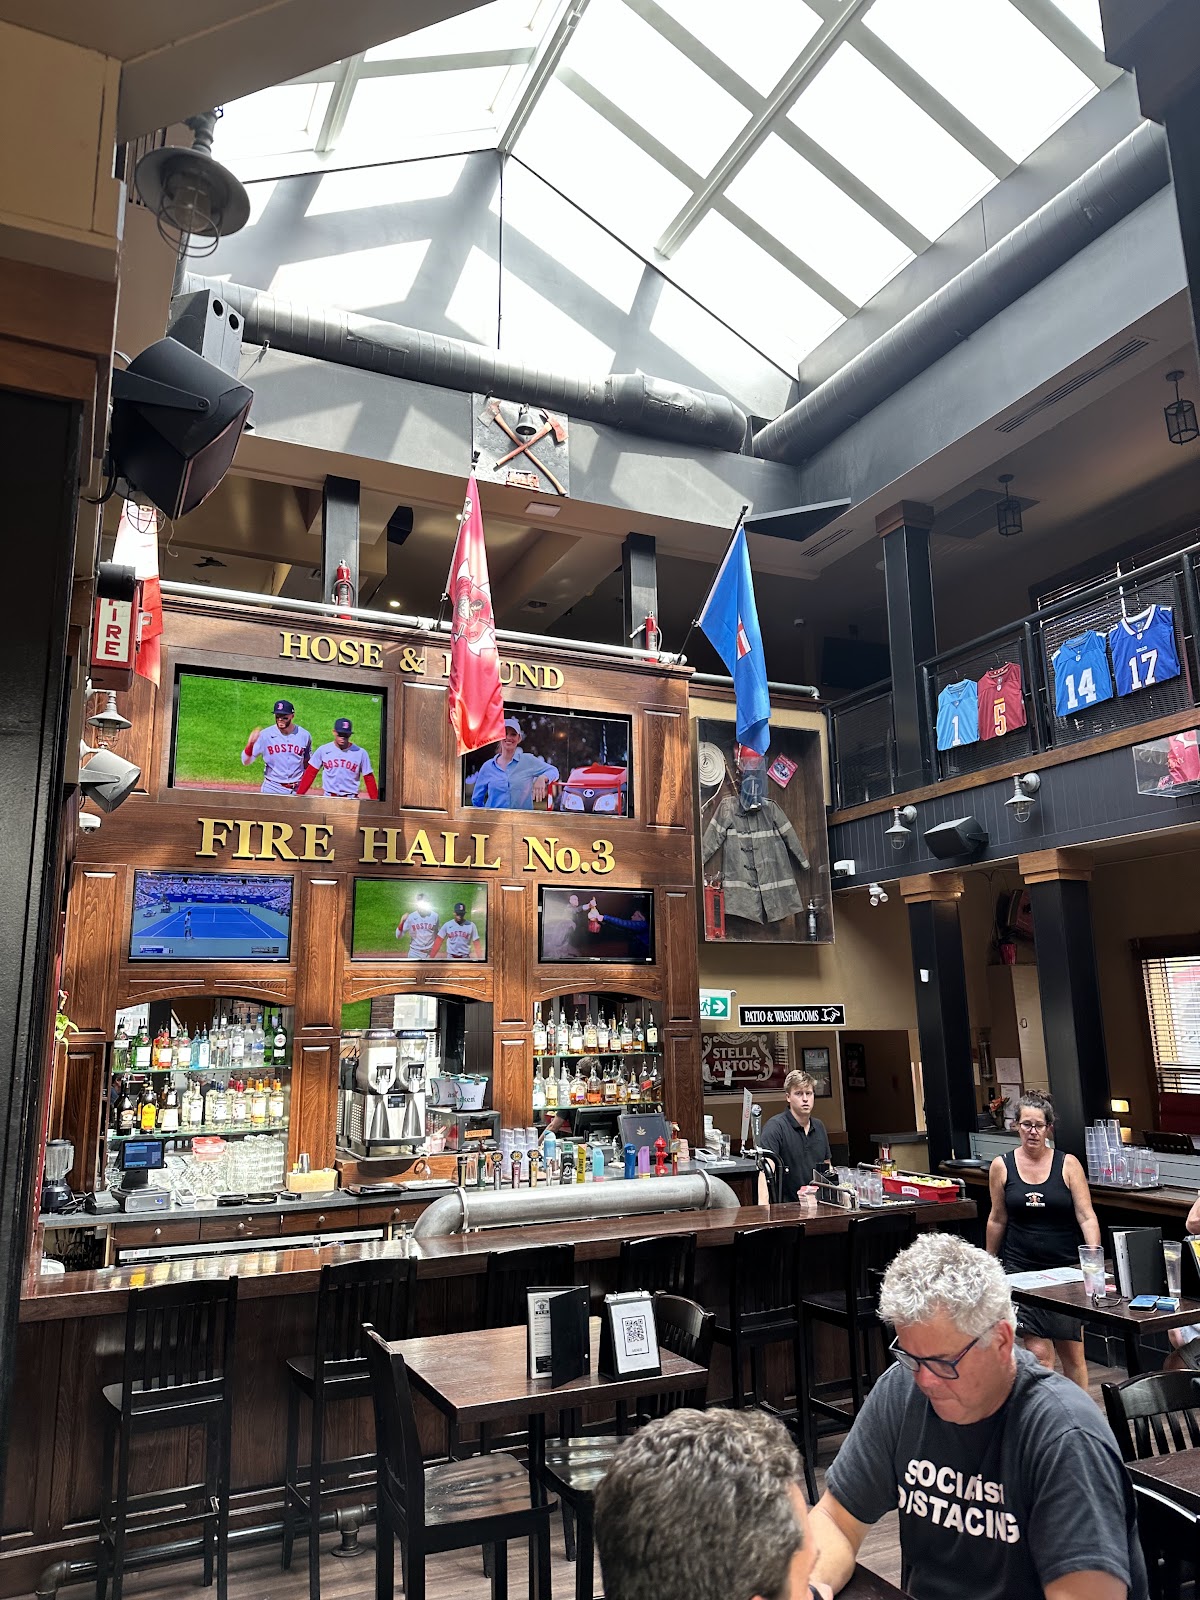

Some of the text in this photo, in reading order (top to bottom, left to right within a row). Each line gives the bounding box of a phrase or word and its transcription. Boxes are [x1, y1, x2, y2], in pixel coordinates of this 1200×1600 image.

[105, 600, 121, 656] IRE
[280, 631, 384, 669] HOSE
[399, 647, 426, 674] &
[1129, 648, 1158, 691] 17
[1065, 667, 1097, 709] 14
[951, 715, 961, 747] 1
[993, 702, 1007, 736] 5
[195, 817, 616, 875] FIRE HALL No.3
[744, 1009, 819, 1023] PATIO & WASHROOMS
[712, 1047, 760, 1059] STELLA
[712, 1059, 761, 1072] ARTOIS
